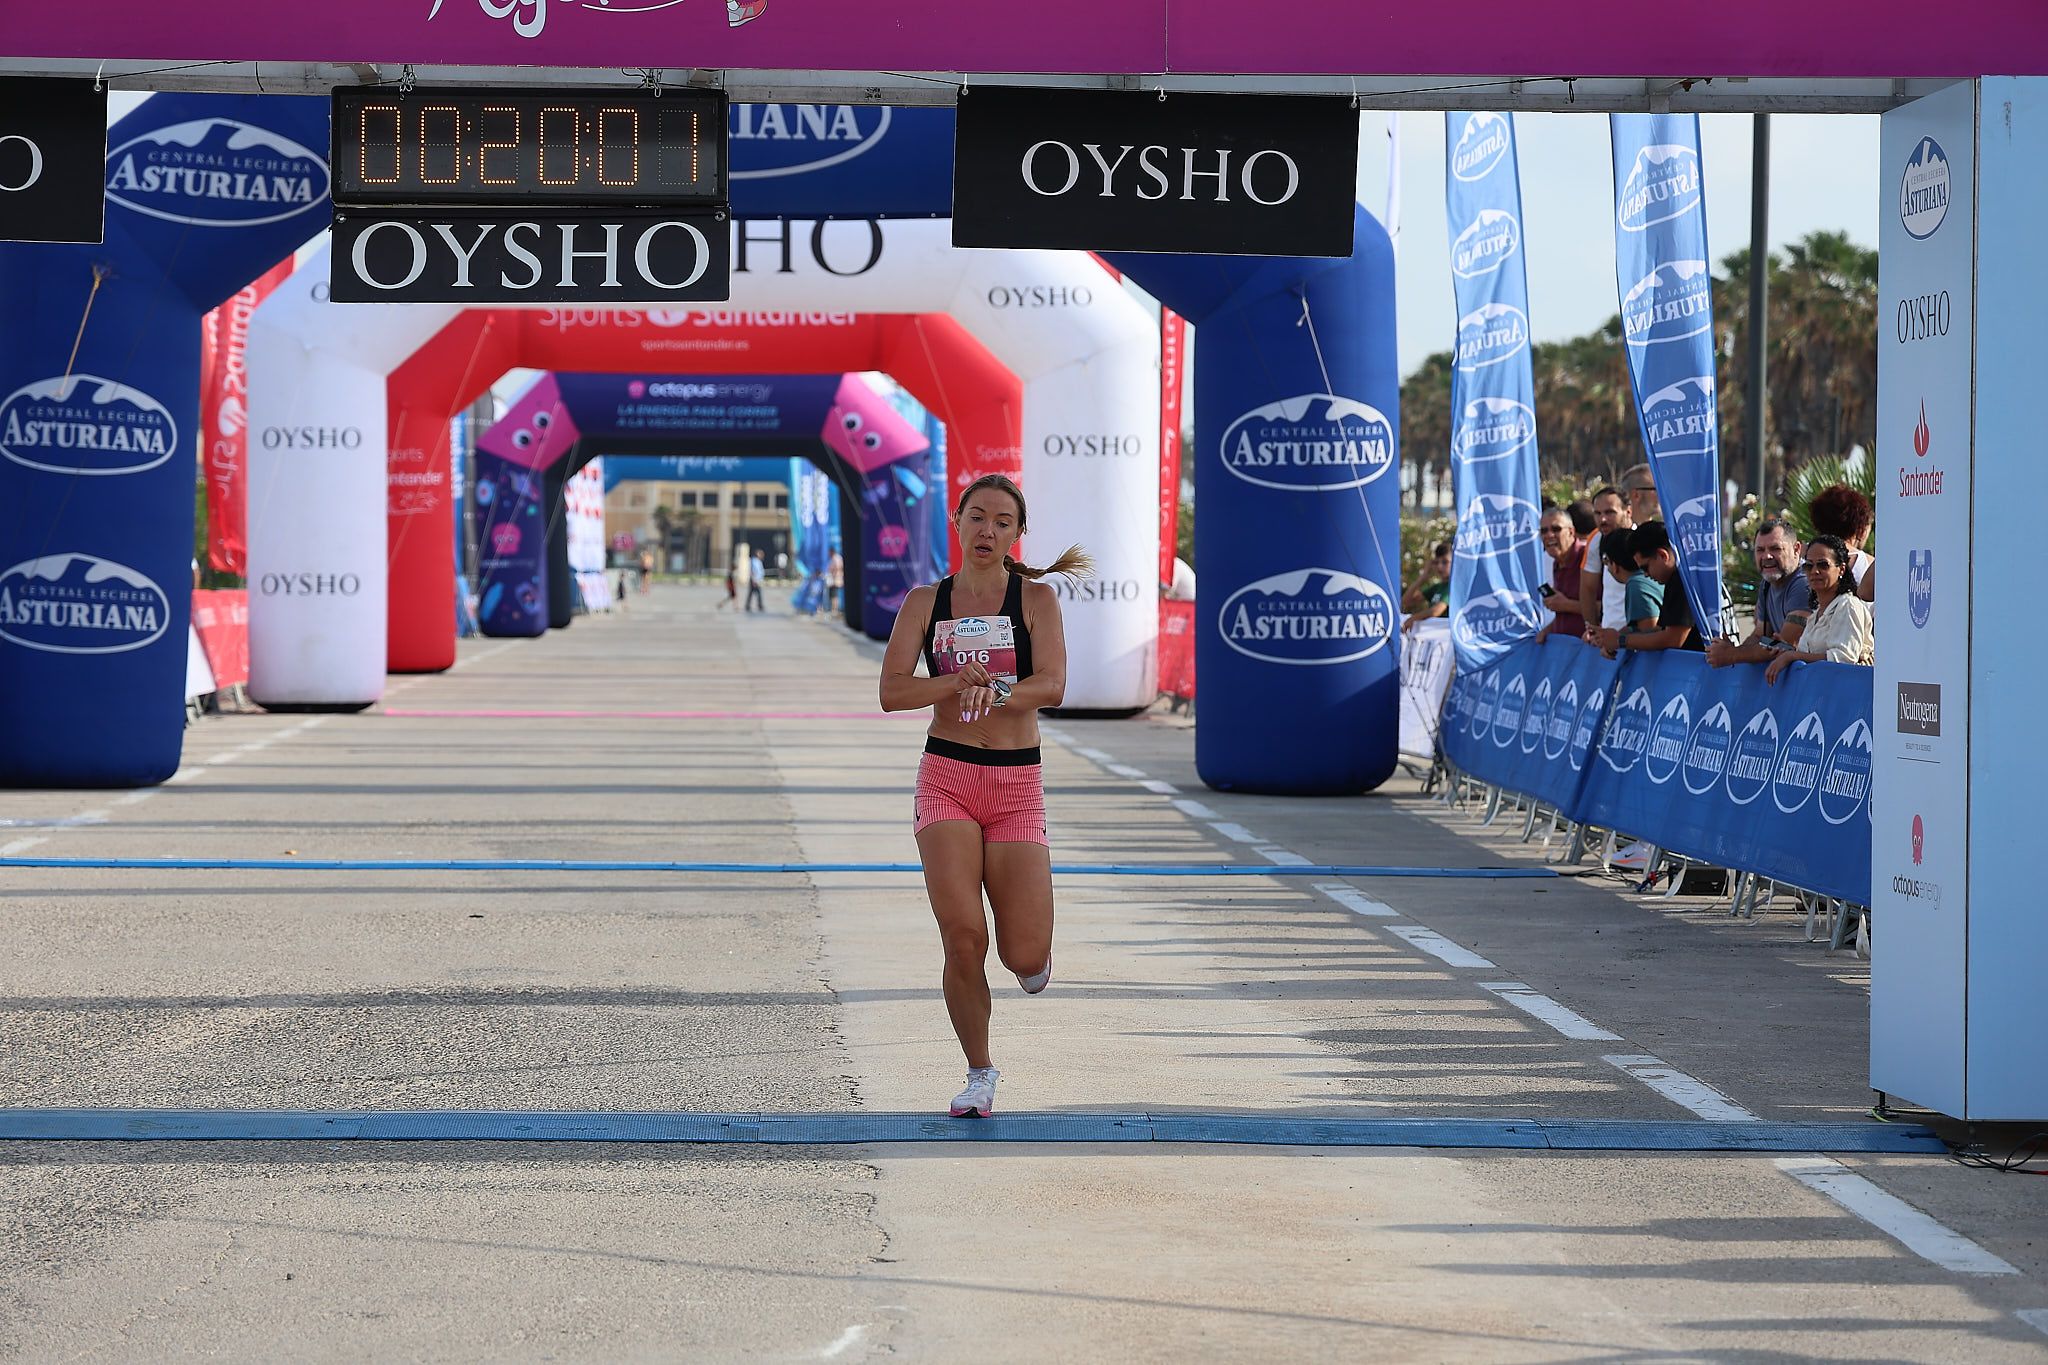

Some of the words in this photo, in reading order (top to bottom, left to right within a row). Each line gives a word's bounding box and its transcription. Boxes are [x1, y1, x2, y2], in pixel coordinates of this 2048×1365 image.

[147, 149, 225, 167] CENTRAL
[232, 156, 311, 173] LECHERA
[361, 105, 698, 186] 00:20:01
[106, 152, 313, 203] ASTURIANA
[1021, 140, 1299, 206] OYSHO
[1903, 180, 1947, 217] ASTURIANA
[351, 221, 710, 291] OYSHO
[988, 285, 1092, 309] OYSHO
[1896, 290, 1950, 344] OYSHO
[3, 407, 166, 455] ASTURIANA
[27, 406, 92, 419] CENTRAL
[98, 410, 162, 425] LECHERA
[1260, 426, 1325, 437] CENTRAL
[1331, 425, 1384, 436] LECHERA
[262, 426, 362, 451] OYSHO
[1043, 433, 1142, 458] OYSHO
[1231, 430, 1387, 466] ASTURIANA
[1899, 467, 1944, 497] Santander
[20, 584, 84, 598] CENTRAL
[90, 589, 154, 603] LECHERA
[260, 572, 360, 597] OYSHO
[0, 586, 158, 632] ASTURIANA
[1230, 603, 1387, 640] ASTURIANA
[1257, 600, 1323, 611] CENTRAL
[1328, 599, 1383, 611] LECHERA
[957, 625, 988, 633] ASTURIANA
[955, 649, 990, 665] 016
[1900, 693, 1938, 729] Neutrogena
[1821, 754, 1866, 800] ASTURIANA
